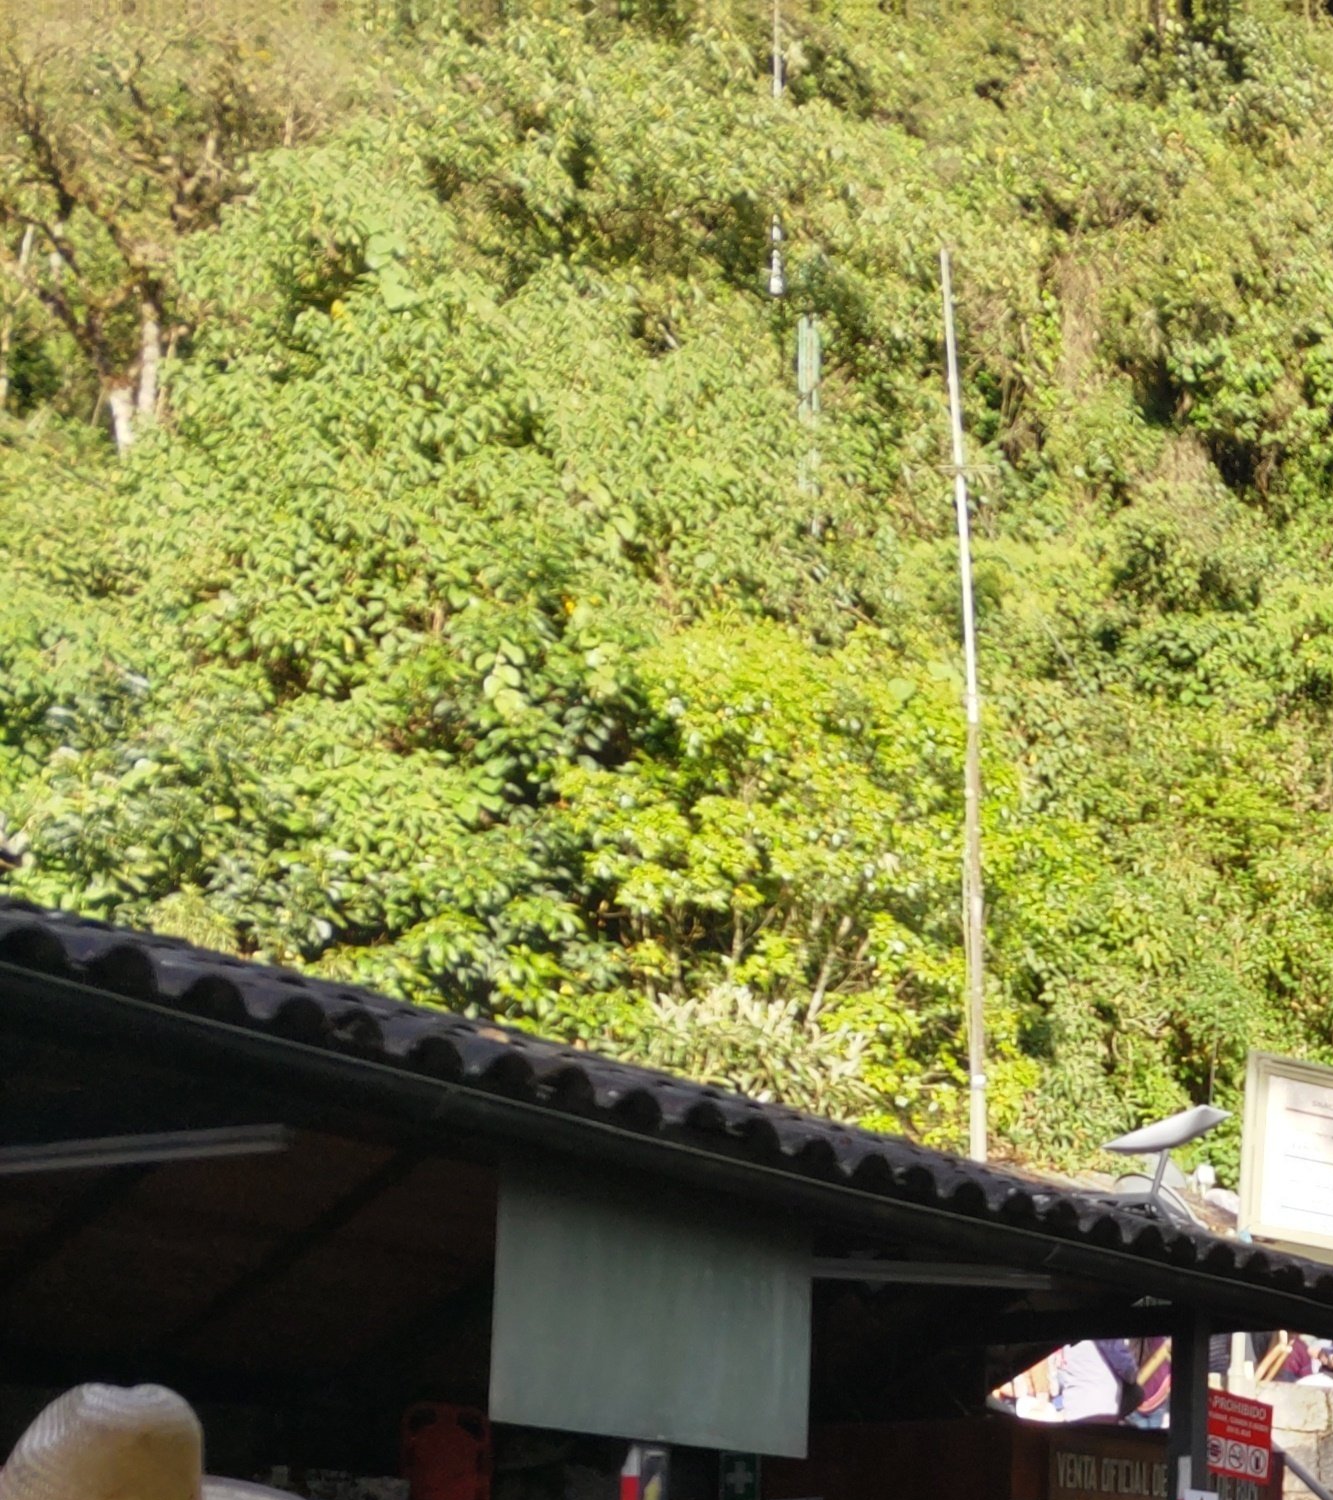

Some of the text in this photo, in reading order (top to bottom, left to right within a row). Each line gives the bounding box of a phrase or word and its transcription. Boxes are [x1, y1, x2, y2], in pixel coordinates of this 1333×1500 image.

[1211, 1395, 1267, 1421] PROHIBIDO
[1056, 1451, 1098, 1491] VENTA
[1101, 1456, 1150, 1497] OFICIAL
